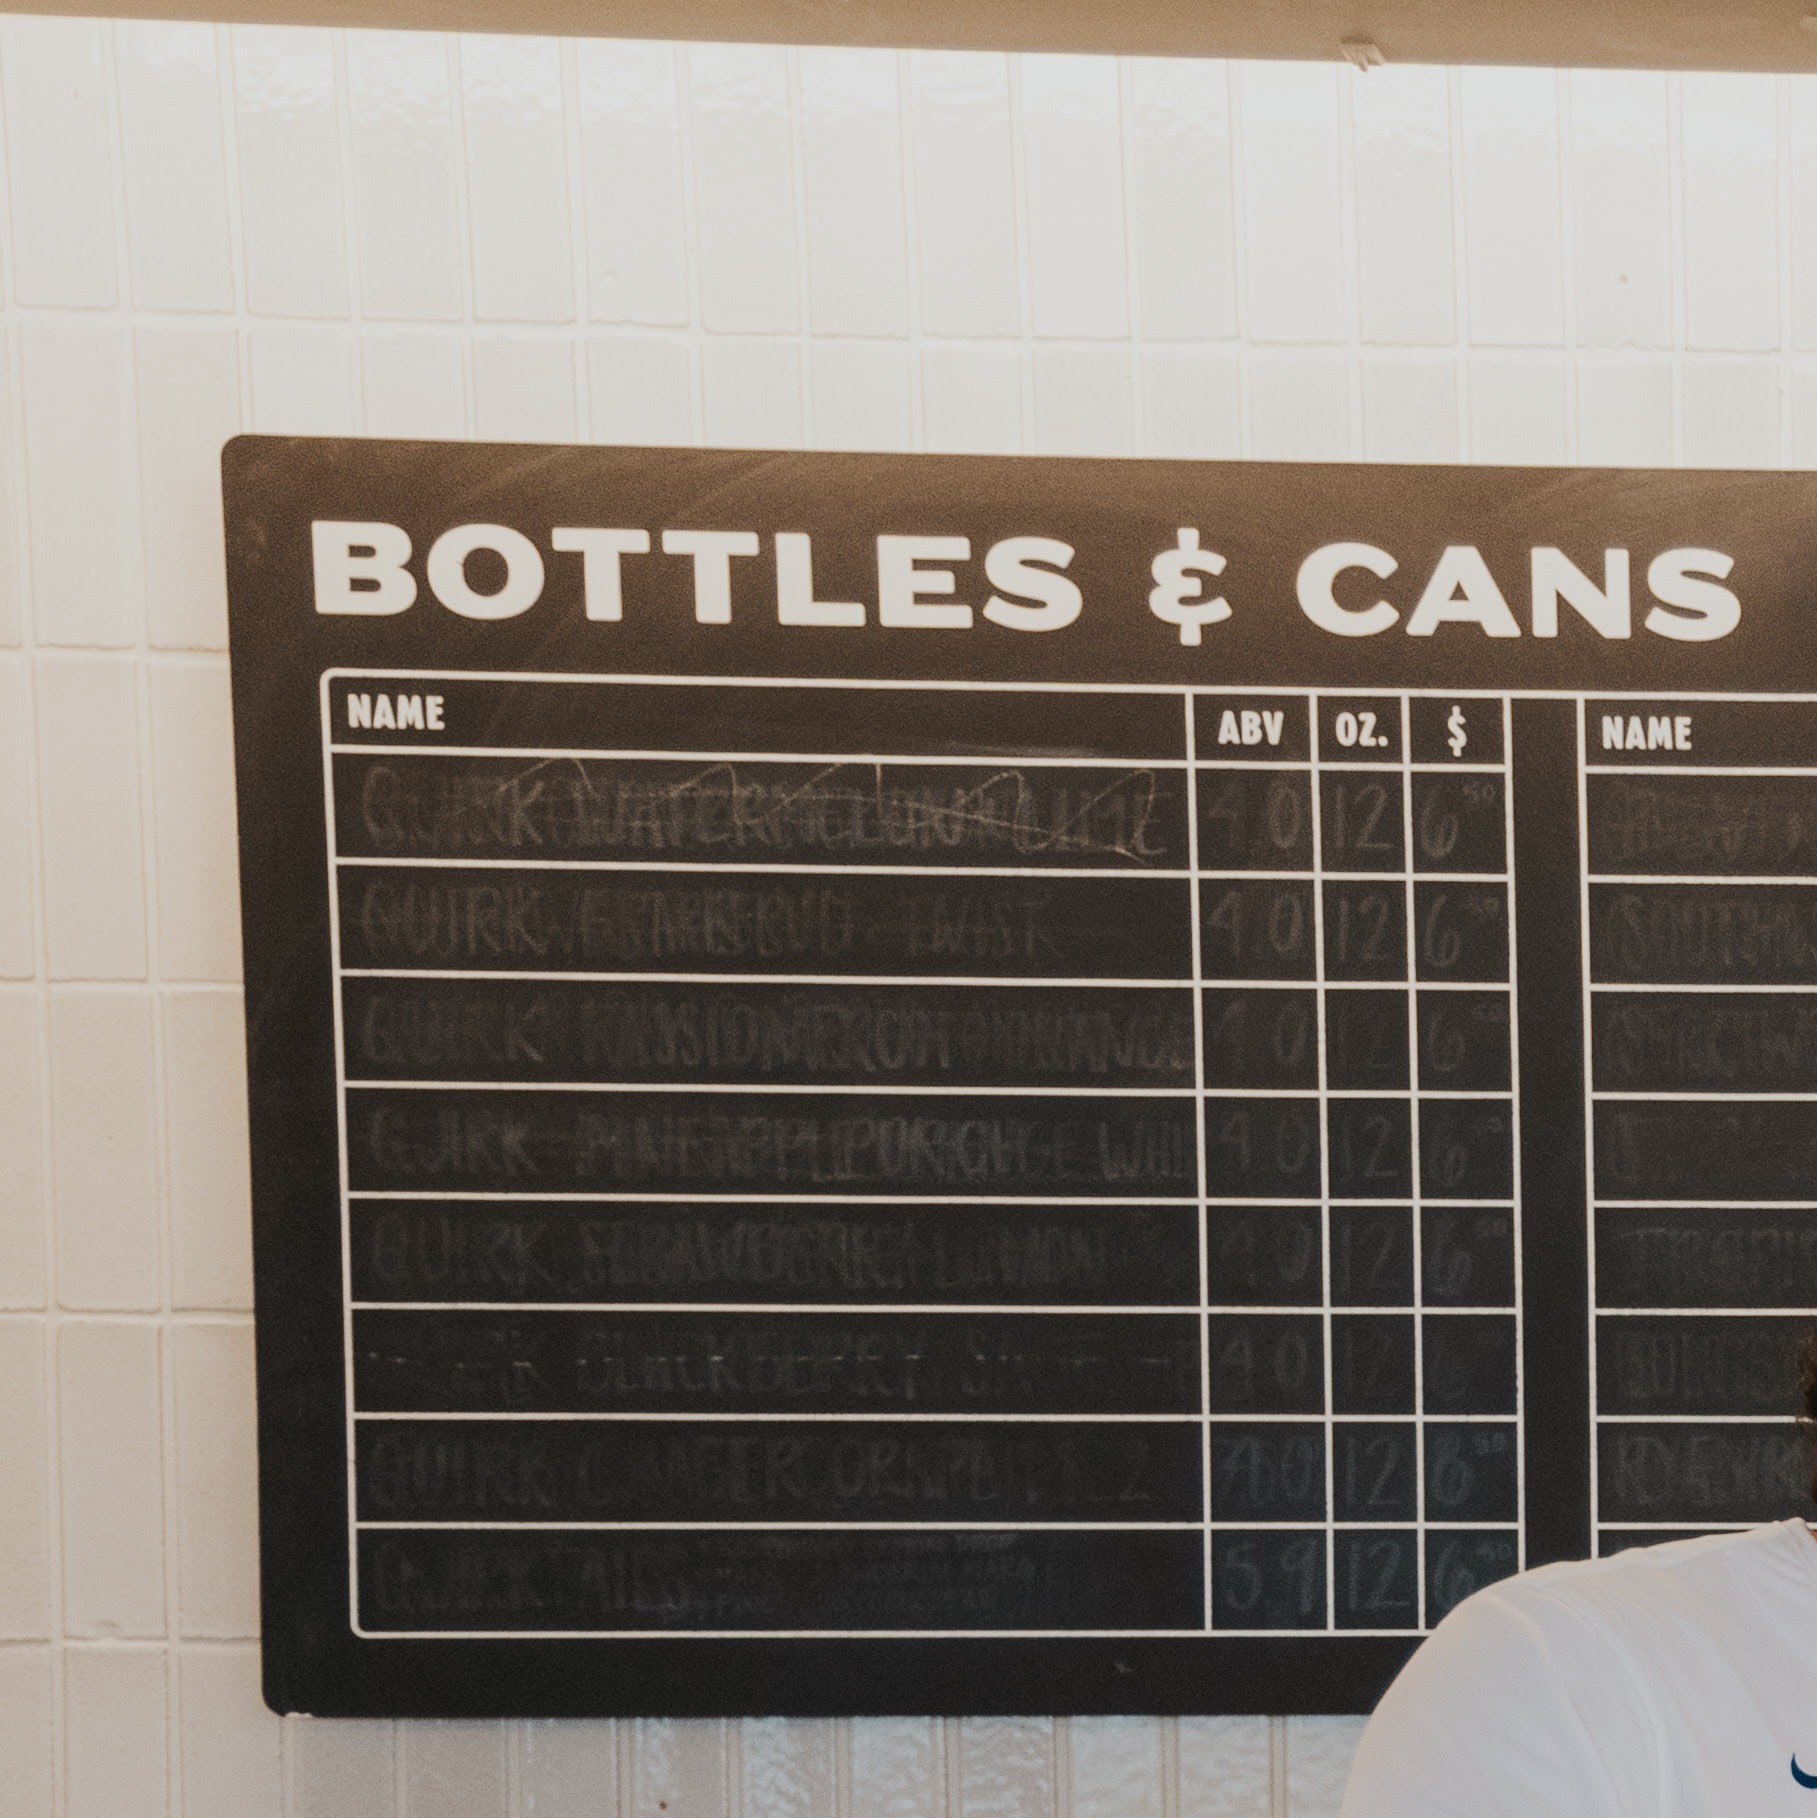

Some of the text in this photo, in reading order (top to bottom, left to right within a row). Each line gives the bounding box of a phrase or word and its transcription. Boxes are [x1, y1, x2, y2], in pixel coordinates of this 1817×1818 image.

[310, 519, 1743, 647] BOTTLES & CANS
[347, 693, 445, 730] NAME
[1217, 709, 1284, 746] ABV
[1335, 711, 1389, 747] OZ.
[1448, 706, 1467, 756] $
[1601, 715, 1692, 751] NAME
